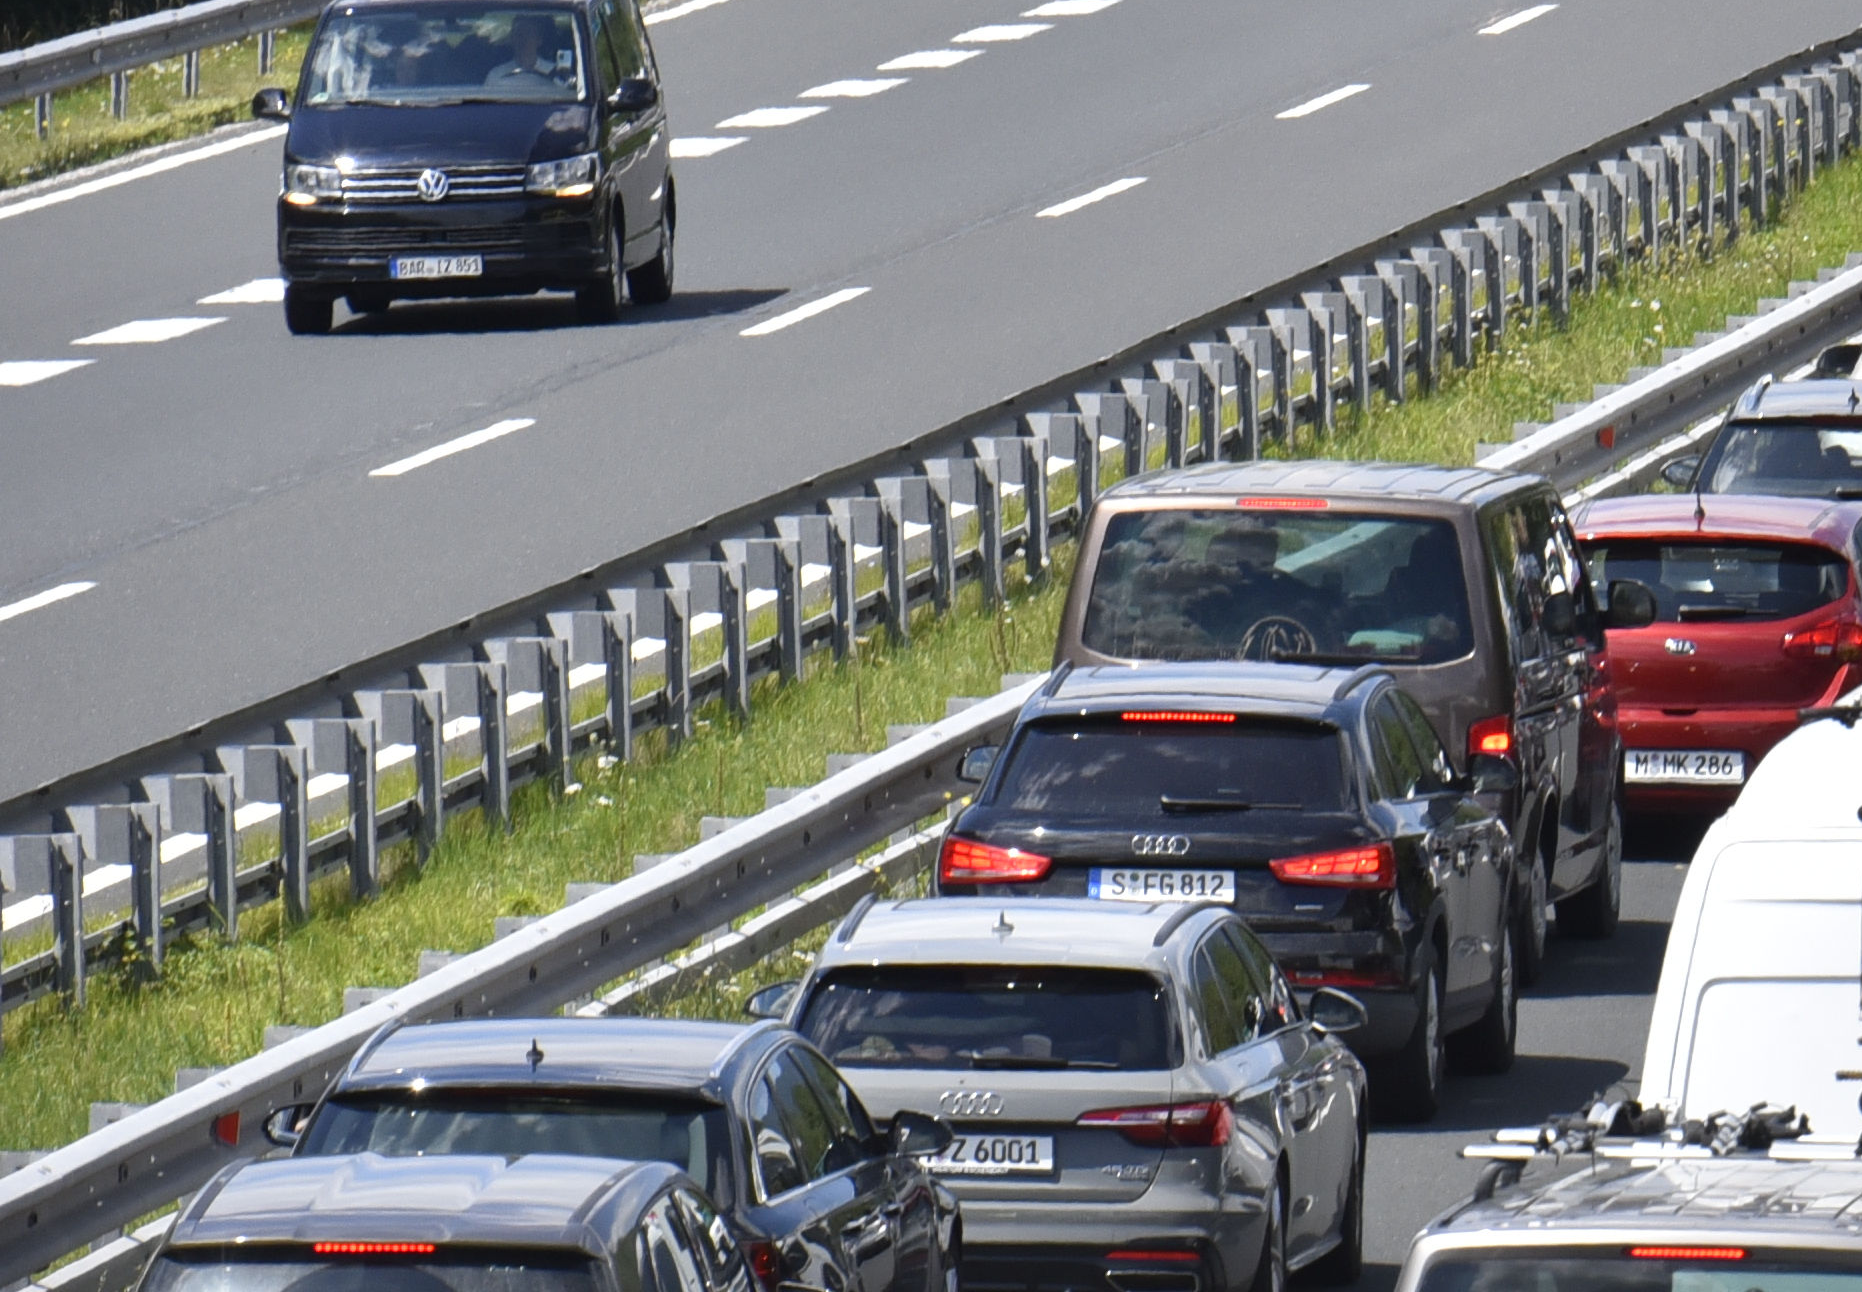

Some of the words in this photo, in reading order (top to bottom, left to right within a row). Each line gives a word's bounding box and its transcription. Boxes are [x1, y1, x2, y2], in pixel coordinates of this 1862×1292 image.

[1635, 753, 1649, 775] M
[1664, 754, 1690, 775] MK
[1694, 755, 1734, 776] 286
[1111, 872, 1126, 896] S
[1143, 873, 1174, 896] FG
[1180, 873, 1225, 897] 812
[951, 1139, 967, 1164] Z
[974, 1139, 1040, 1164] 6001
